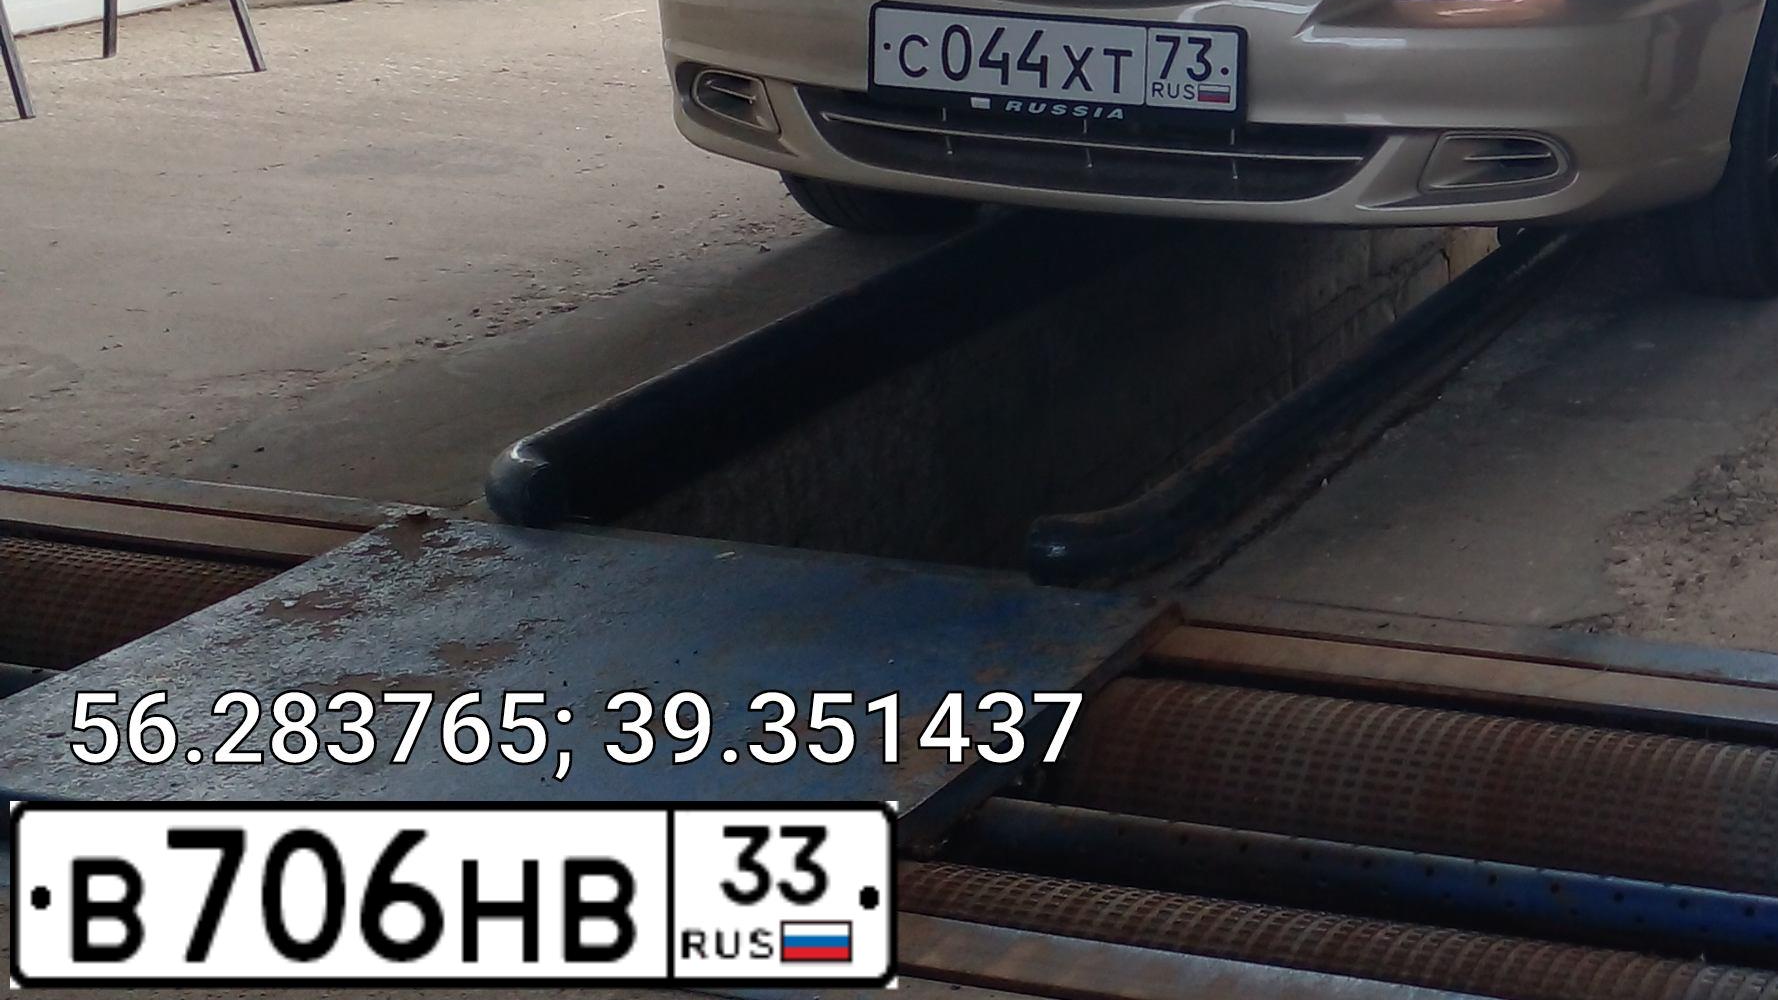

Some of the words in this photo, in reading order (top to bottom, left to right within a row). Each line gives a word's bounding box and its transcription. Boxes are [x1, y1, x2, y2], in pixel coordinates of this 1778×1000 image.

[898, 23, 1133, 93] С044ХТ
[1154, 34, 1213, 82] 73
[1151, 82, 1196, 101] RUS
[1005, 99, 1126, 120] RUSSIA
